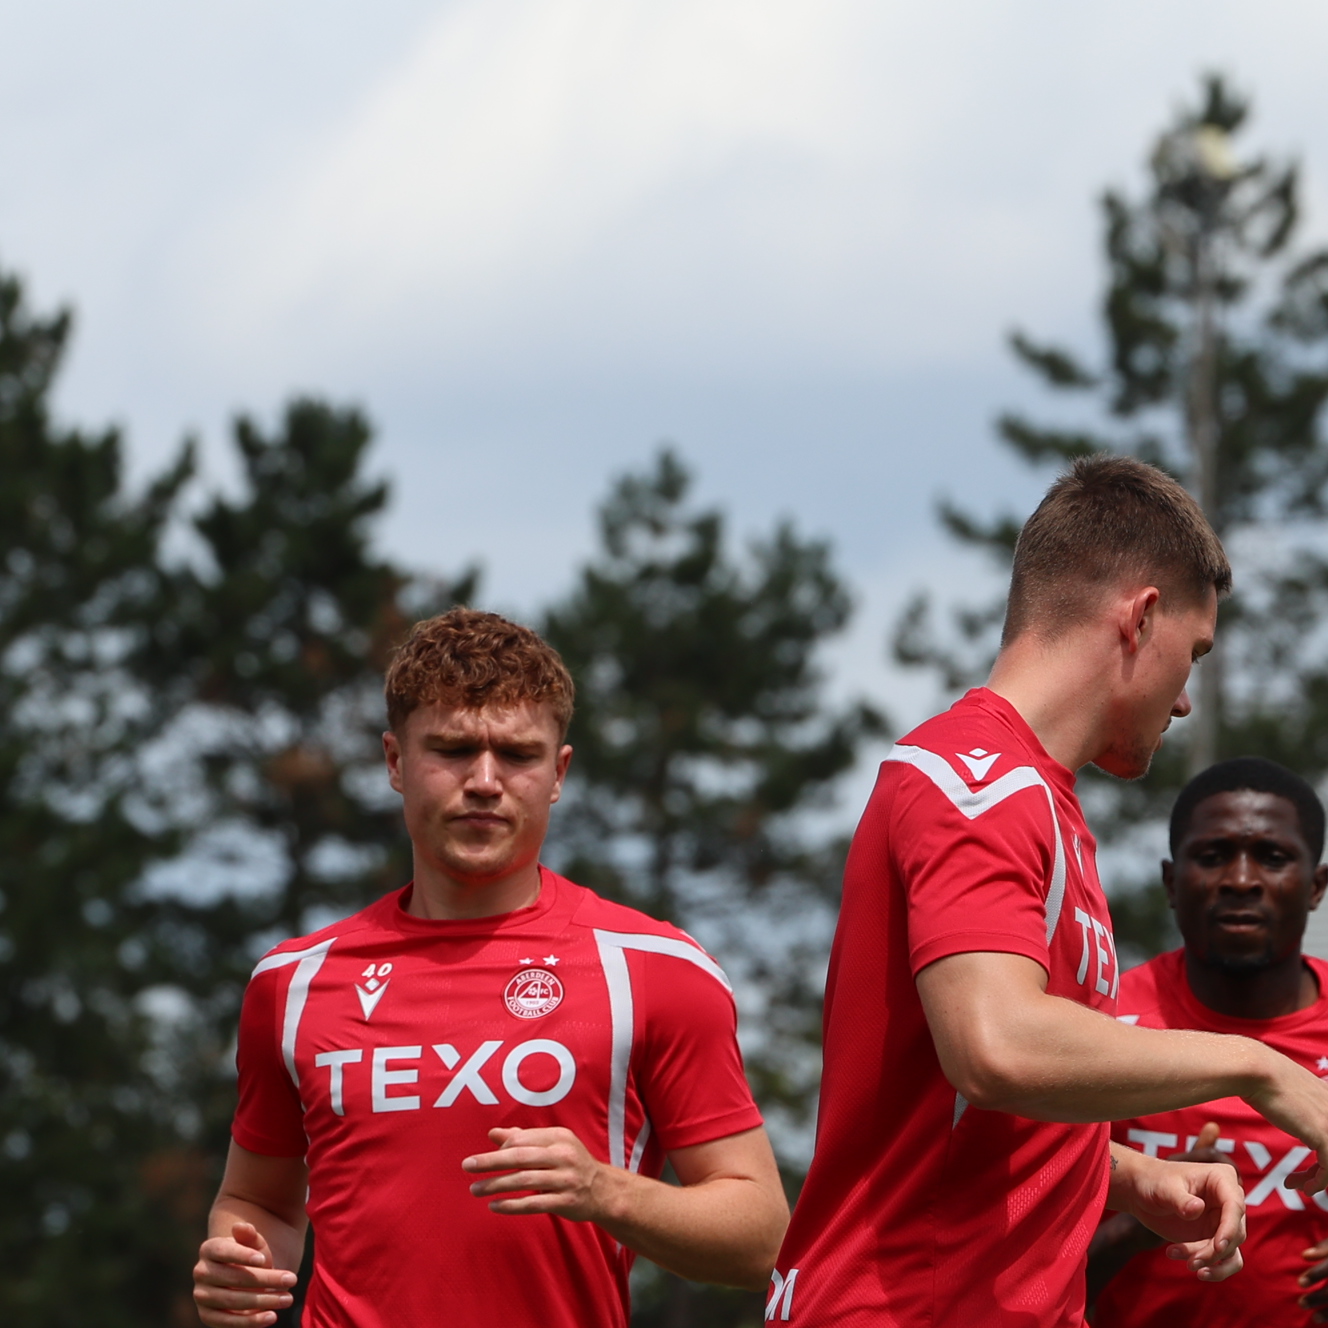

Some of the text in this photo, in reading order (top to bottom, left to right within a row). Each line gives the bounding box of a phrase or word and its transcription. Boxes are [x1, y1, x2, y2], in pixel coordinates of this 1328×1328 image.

[361, 963, 393, 978] 40
[516, 972, 556, 986] ABERDEEN
[507, 996, 559, 1016] FOOTBALL CLUB
[315, 1038, 576, 1117] TEXO
